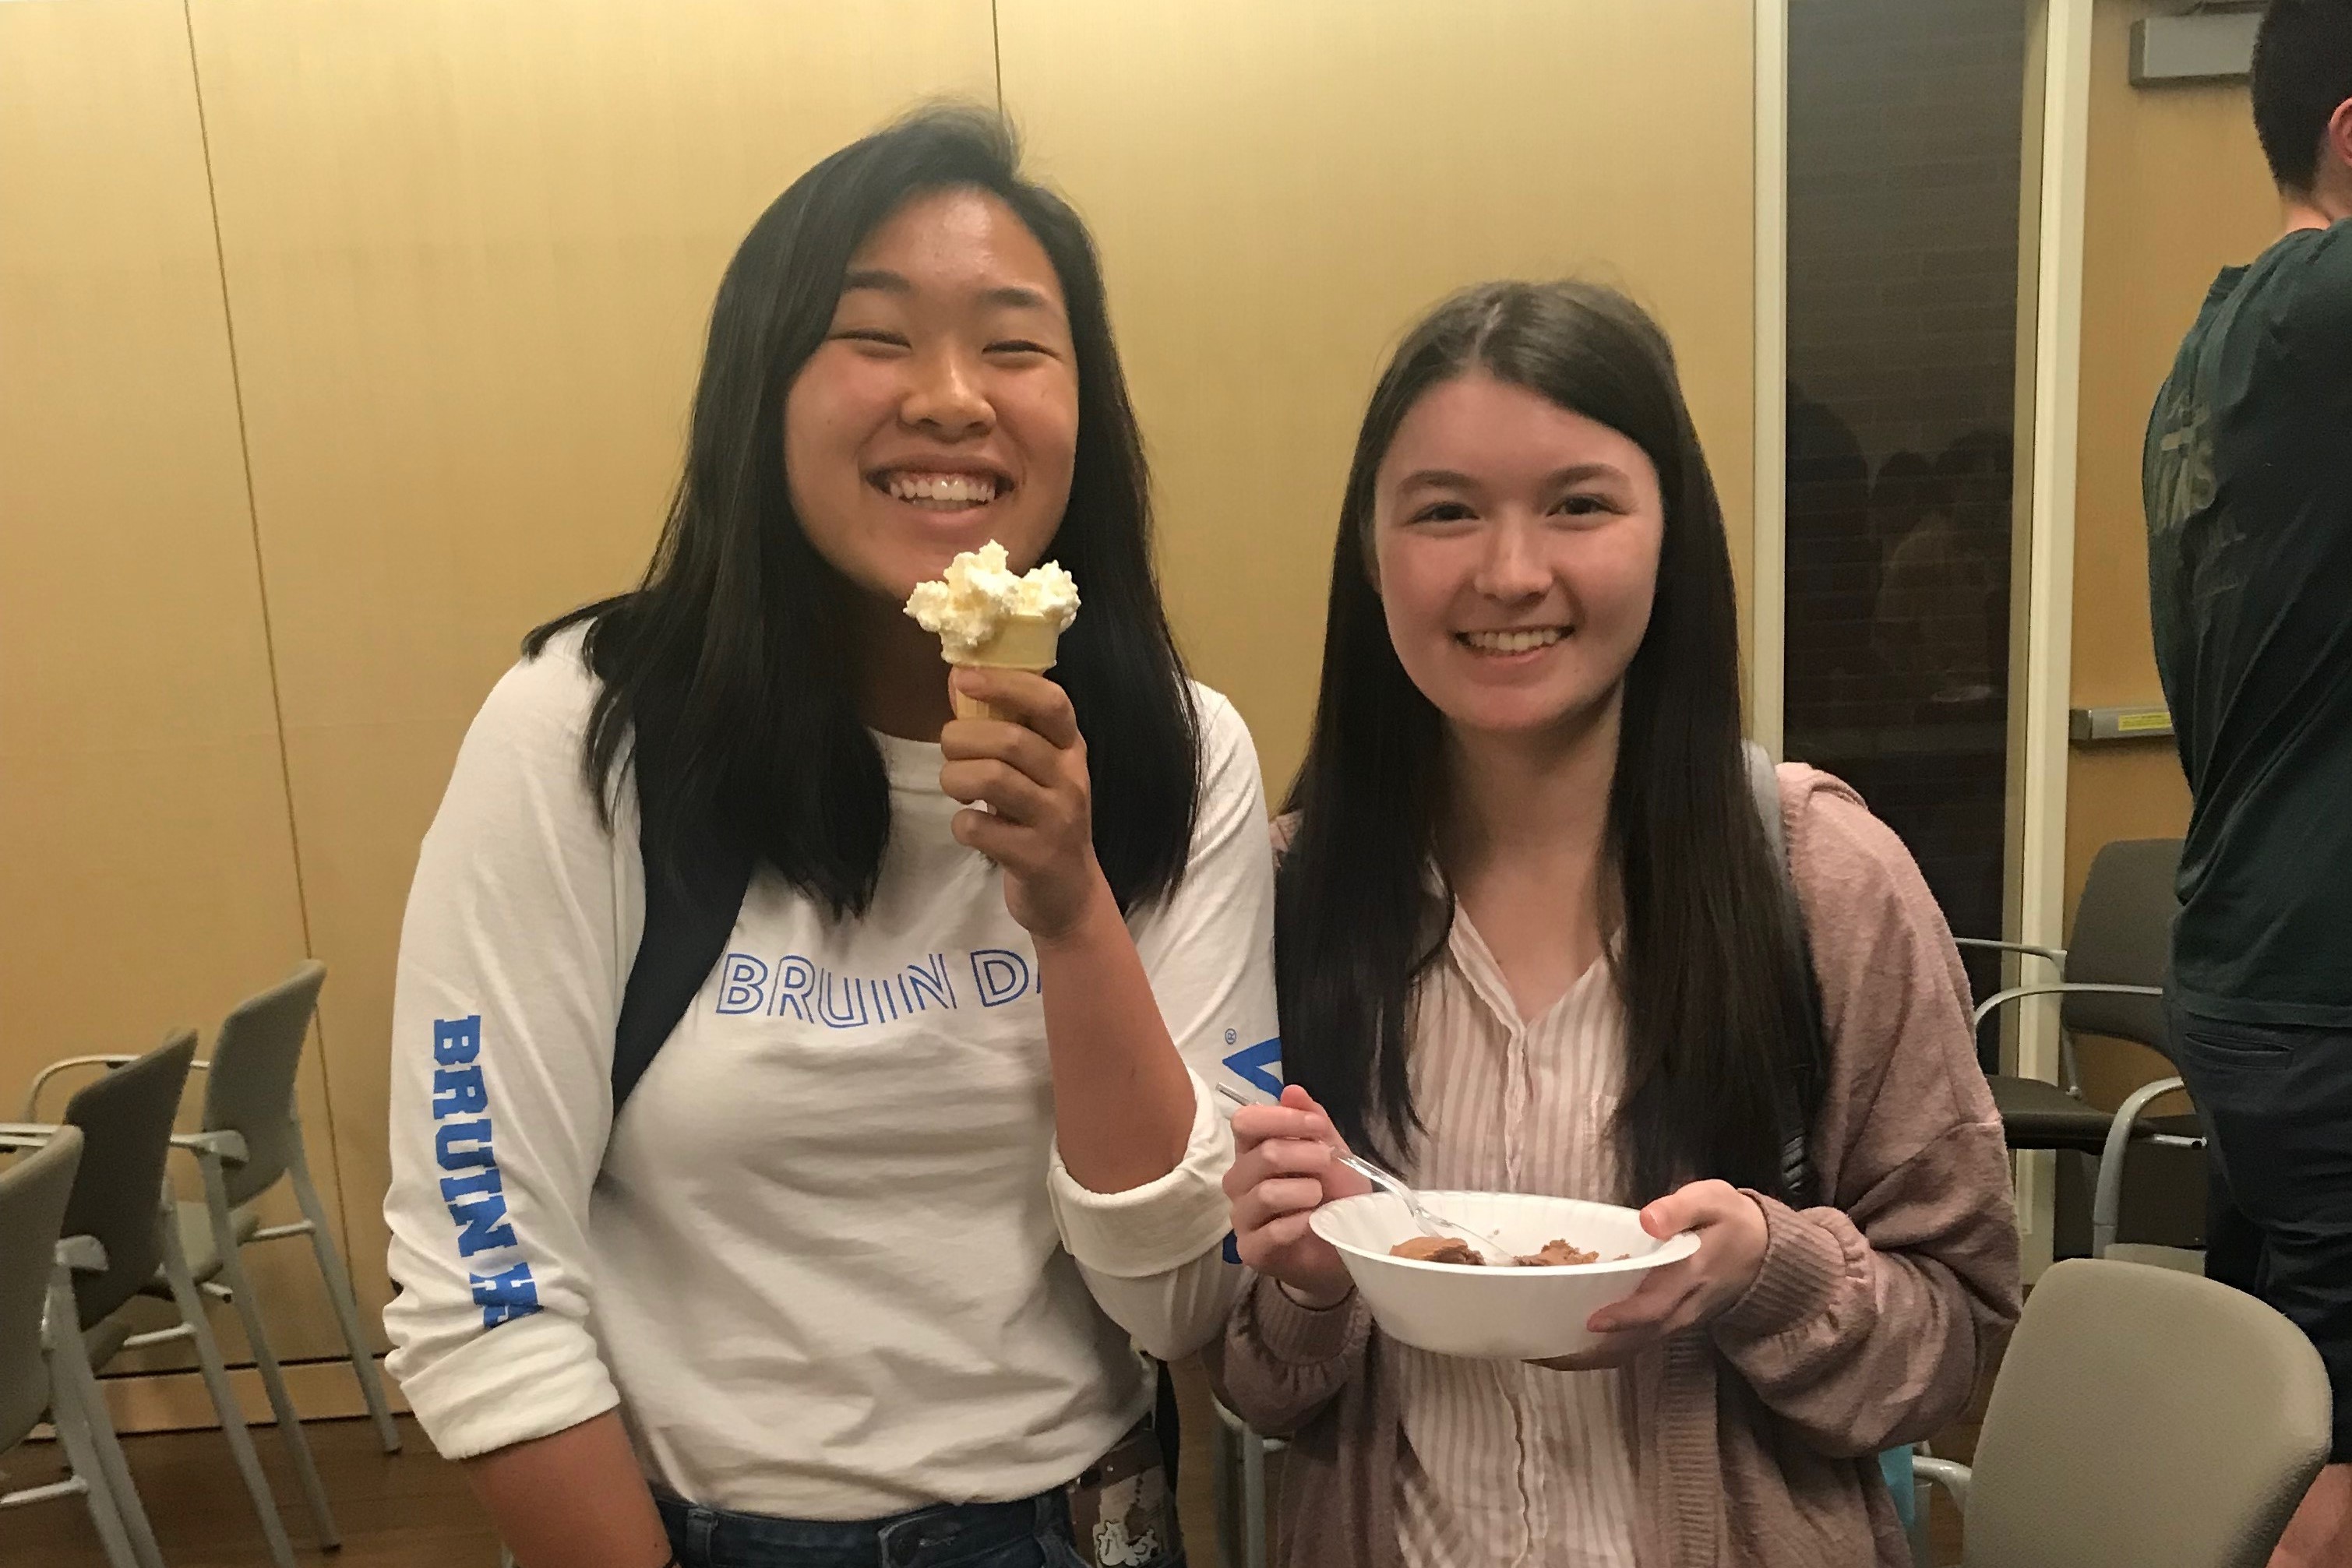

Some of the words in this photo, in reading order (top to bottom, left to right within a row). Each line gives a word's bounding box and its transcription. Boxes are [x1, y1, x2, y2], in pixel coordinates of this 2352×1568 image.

[715, 953, 957, 1029] BRUIN
[970, 949, 1042, 1007] D
[432, 1014, 518, 1258] BRUIN
